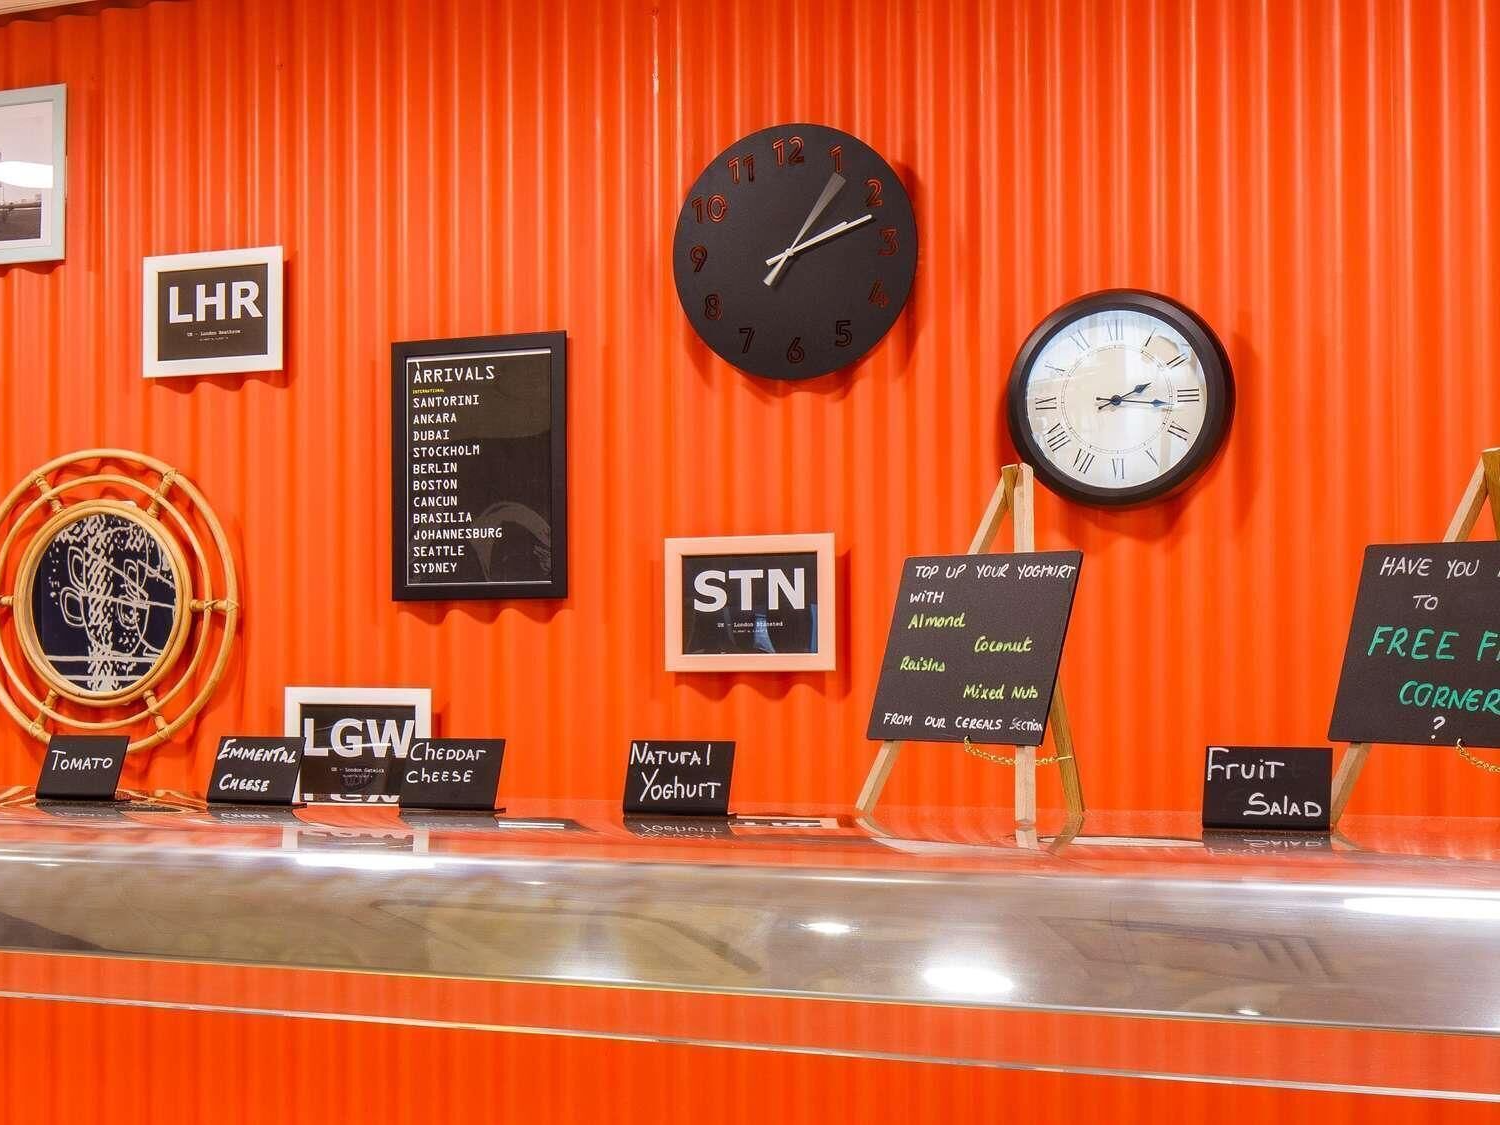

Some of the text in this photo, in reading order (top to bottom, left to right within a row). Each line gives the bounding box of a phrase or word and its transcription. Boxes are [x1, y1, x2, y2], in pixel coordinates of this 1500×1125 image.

[773, 136, 804, 166] 12
[830, 145, 842, 173] 1
[727, 155, 755, 183] 11
[865, 178, 883, 208] 2
[692, 194, 727, 223] 10
[878, 228, 900, 256] 3
[690, 247, 707, 272] 9
[169, 280, 263, 324] LHR
[868, 282, 889, 308] 4
[704, 294, 722, 320] 8
[739, 327, 755, 353] 7
[835, 320, 853, 347] 5
[787, 337, 804, 364] 6
[413, 366, 495, 383] ARRIVALS
[412, 395, 480, 408] SANTORINI
[413, 413, 457, 424] ANKARA
[413, 430, 450, 441] DUBAI
[413, 445, 480, 458] STOCKHOLM
[413, 463, 457, 474] BERLIN
[413, 480, 457, 491] BOSTON
[413, 496, 457, 507] CANCUN
[413, 513, 472, 524] BRASILIA
[413, 528, 502, 540] JOHANNESBURG
[413, 546, 464, 557] SEATTLE
[413, 562, 457, 574] SYDNEY
[915, 564, 1076, 579] TOP UP YOUR YOGHURT
[1379, 556, 1479, 579] HAVE YOU
[694, 568, 805, 612] STN
[1412, 594, 1438, 610] TO
[908, 613, 965, 629] Almond
[974, 636, 1033, 652] Coconut
[1367, 625, 1459, 661] FREE
[900, 656, 945, 672] Raisins
[963, 684, 1038, 699] Mixed Nuts
[1399, 680, 1500, 715] CORNER
[883, 712, 912, 726] FROM
[925, 716, 946, 729] OUR
[955, 716, 1002, 730] CEREALS
[303, 718, 416, 758] LGW
